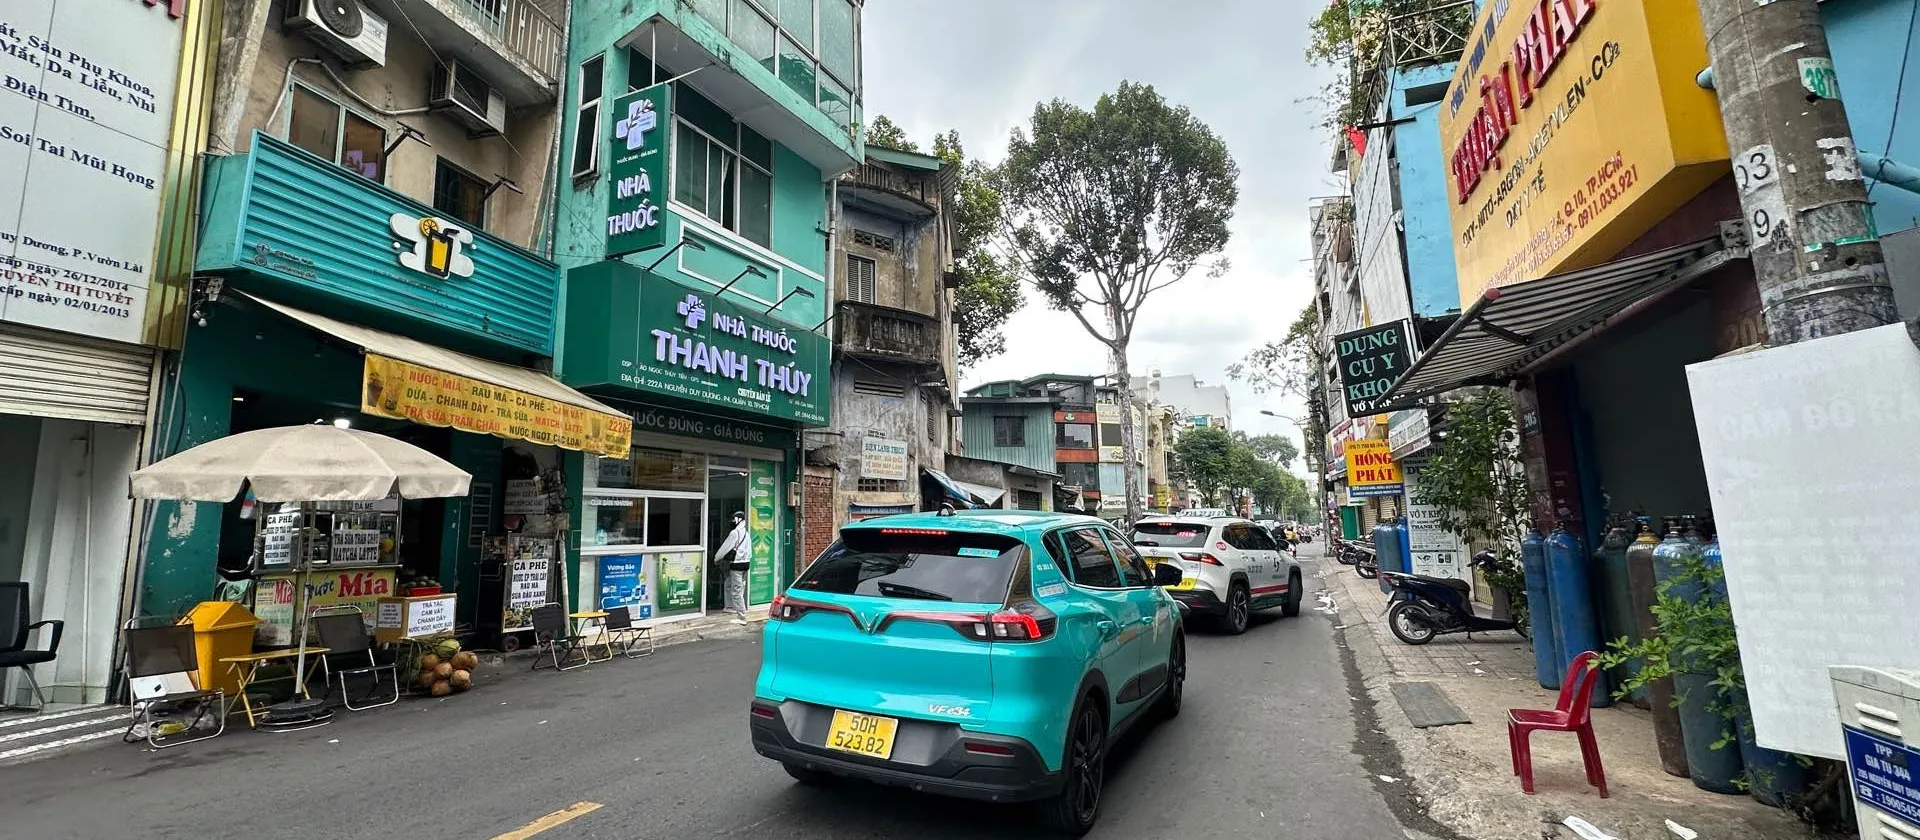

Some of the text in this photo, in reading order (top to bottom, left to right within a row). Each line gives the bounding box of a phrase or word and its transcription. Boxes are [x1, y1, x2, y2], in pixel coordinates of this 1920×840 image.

[0, 39, 41, 68] Mắt,
[47, 59, 72, 79] Da
[80, 72, 122, 101] Liễu,
[28, 35, 62, 59] Sản
[68, 51, 102, 77] Phụ
[107, 68, 155, 98] Khoa,
[4, 75, 48, 102] Điện
[1451, 61, 1517, 205] THUẬN
[0, 125, 156, 190] Soi Tai Mũi Họng
[617, 167, 650, 199] NHÀ
[1578, 163, 1639, 230] 0911.033.921
[608, 198, 659, 236] THUỐC
[22, 236, 69, 256] Dương,
[27, 262, 60, 277] ngày
[63, 269, 129, 292] 26/12/2014
[54, 280, 82, 296] THỊ
[28, 291, 61, 306] ngày
[64, 297, 129, 318] 02/01/2013
[711, 311, 748, 340] NHÀ
[751, 327, 797, 355] THUỐC
[1339, 329, 1397, 356] DỤNG
[651, 328, 812, 397] THANH THÚY
[1348, 352, 1395, 377] CỤ Y
[409, 370, 438, 387] NƯỚC
[472, 386, 491, 399] RAU
[647, 379, 663, 390] 222A
[664, 382, 688, 395] NGUYỄN
[689, 388, 701, 397] DUY
[406, 387, 427, 401] DỪA
[436, 394, 468, 411] CHANH
[1368, 401, 1375, 410] Y
[426, 408, 446, 423] SỮA
[509, 425, 530, 437] NƯỚC
[627, 408, 665, 428] HUỐC
[669, 415, 703, 432] ĐÚNG
[735, 426, 764, 443] ĐÚNG
[1354, 450, 1392, 466] HỒNG
[1356, 466, 1395, 482] PHÁT
[333, 545, 377, 562] MATCHA LATTE
[337, 570, 388, 598] Mía
[421, 609, 433, 617] CAM
[849, 712, 878, 732] 50H
[928, 704, 946, 716] VF
[835, 731, 884, 754] 523.82
[1873, 743, 1892, 757] TPP
